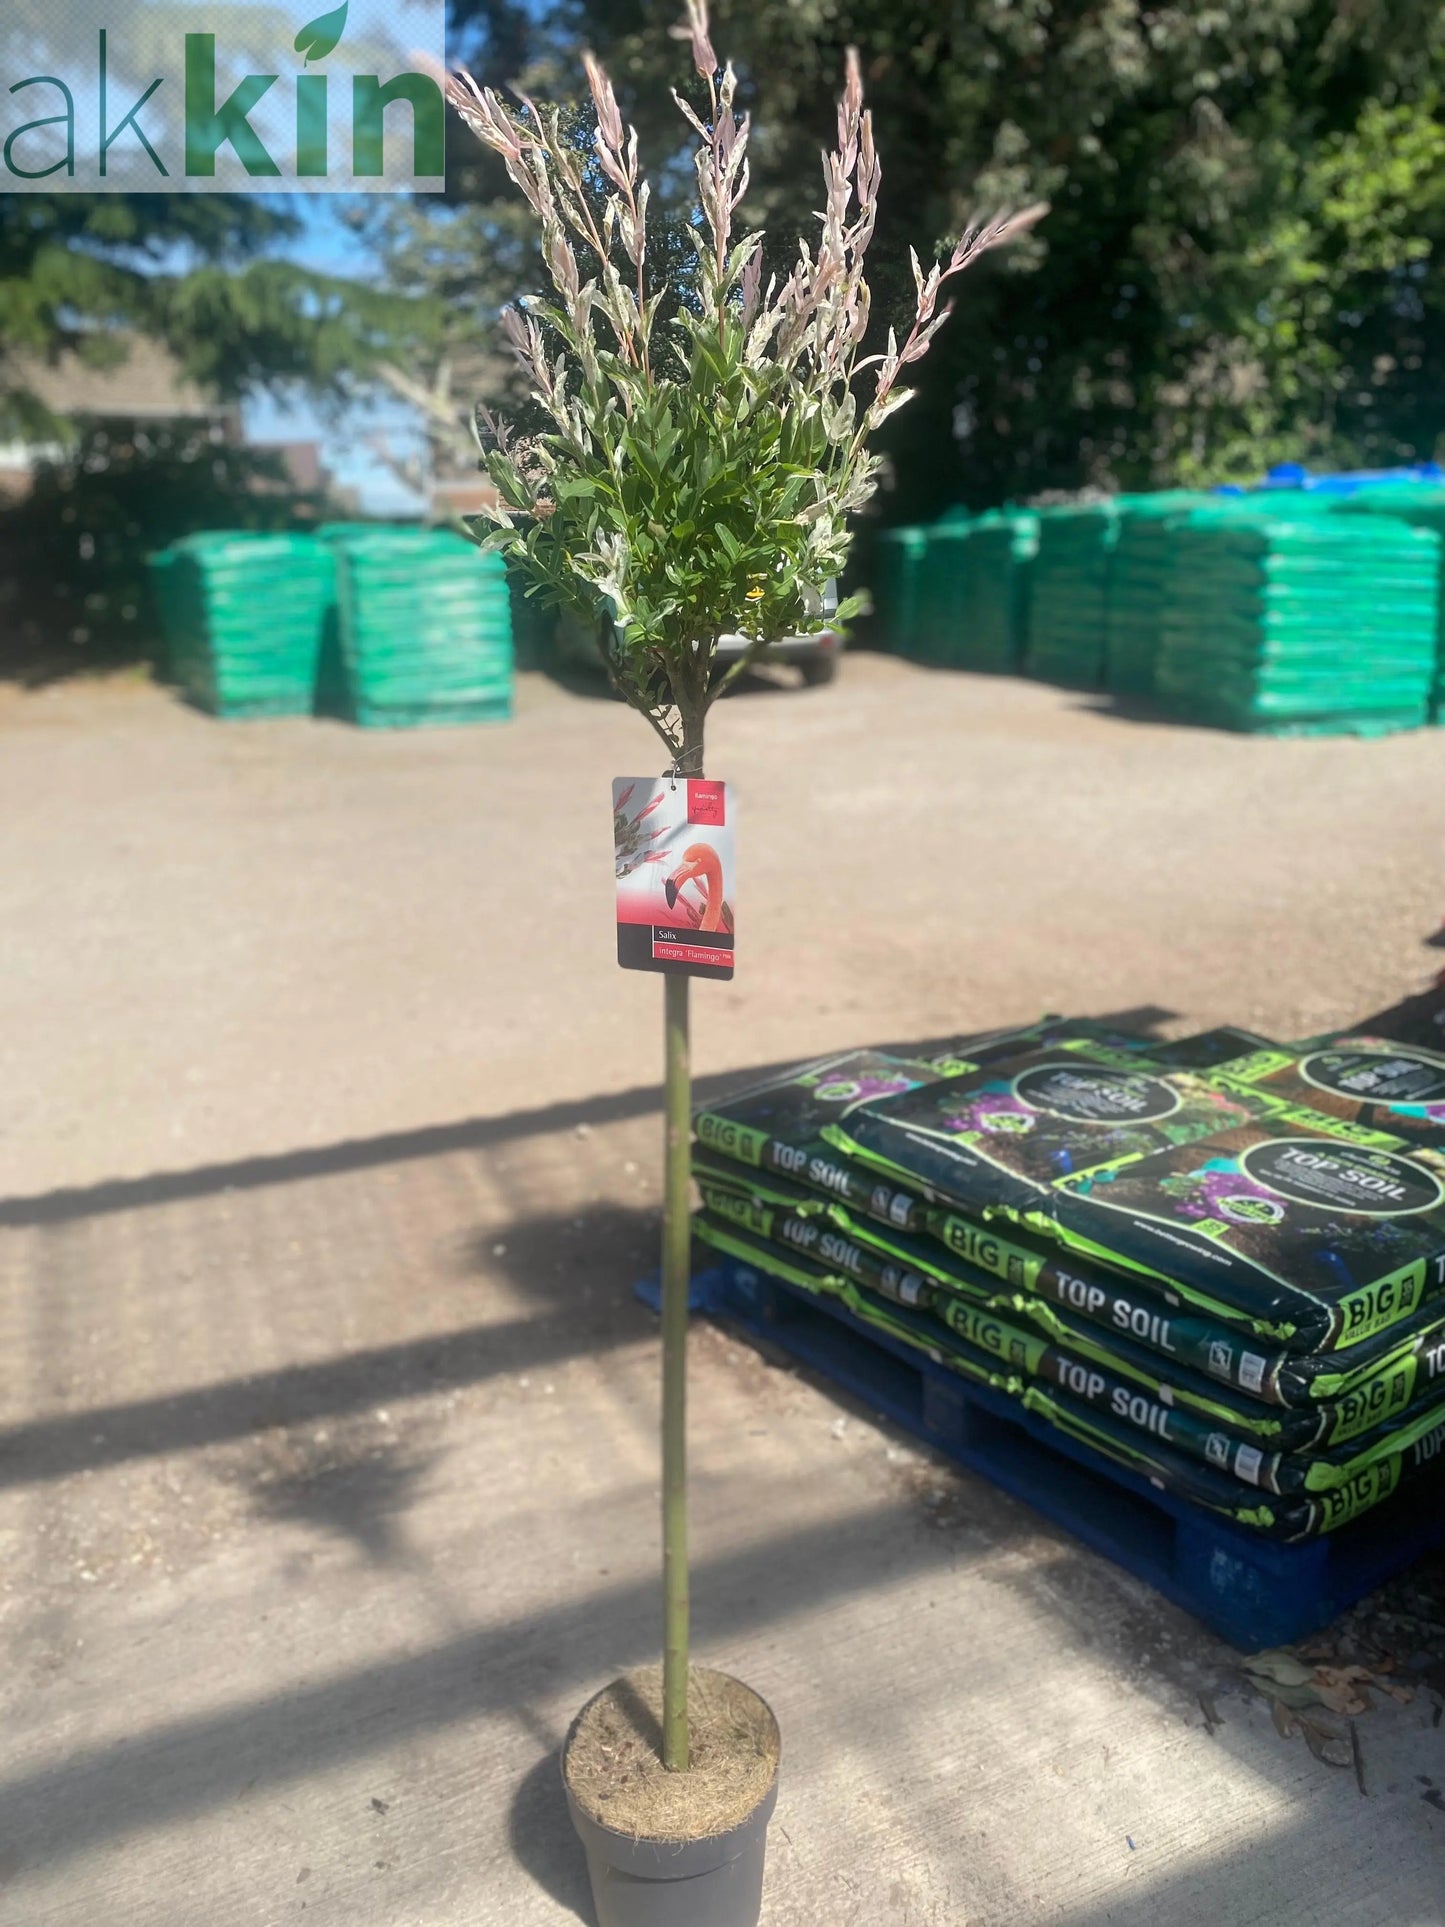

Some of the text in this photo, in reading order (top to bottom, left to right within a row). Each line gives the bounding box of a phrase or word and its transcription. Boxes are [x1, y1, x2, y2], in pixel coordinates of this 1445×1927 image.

[694, 792, 719, 800] flamingo
[659, 931, 677, 940] Salix
[701, 1117, 736, 1147] BIG
[772, 1140, 807, 1172] TOP
[809, 1157, 852, 1196] SOIL
[1280, 1147, 1339, 1170] TOP
[1338, 1168, 1407, 1201] SOIL
[783, 1218, 862, 1273] TOP SOIL
[950, 1224, 999, 1267] BIG
[953, 1306, 1001, 1349] BIG
[1056, 1271, 1176, 1351] TOP SOIL
[1348, 1283, 1395, 1329] BIG
[1056, 1356, 1173, 1442] TOP SOIL
[1341, 1380, 1385, 1426] BIG
[1331, 1468, 1372, 1518] BIG
